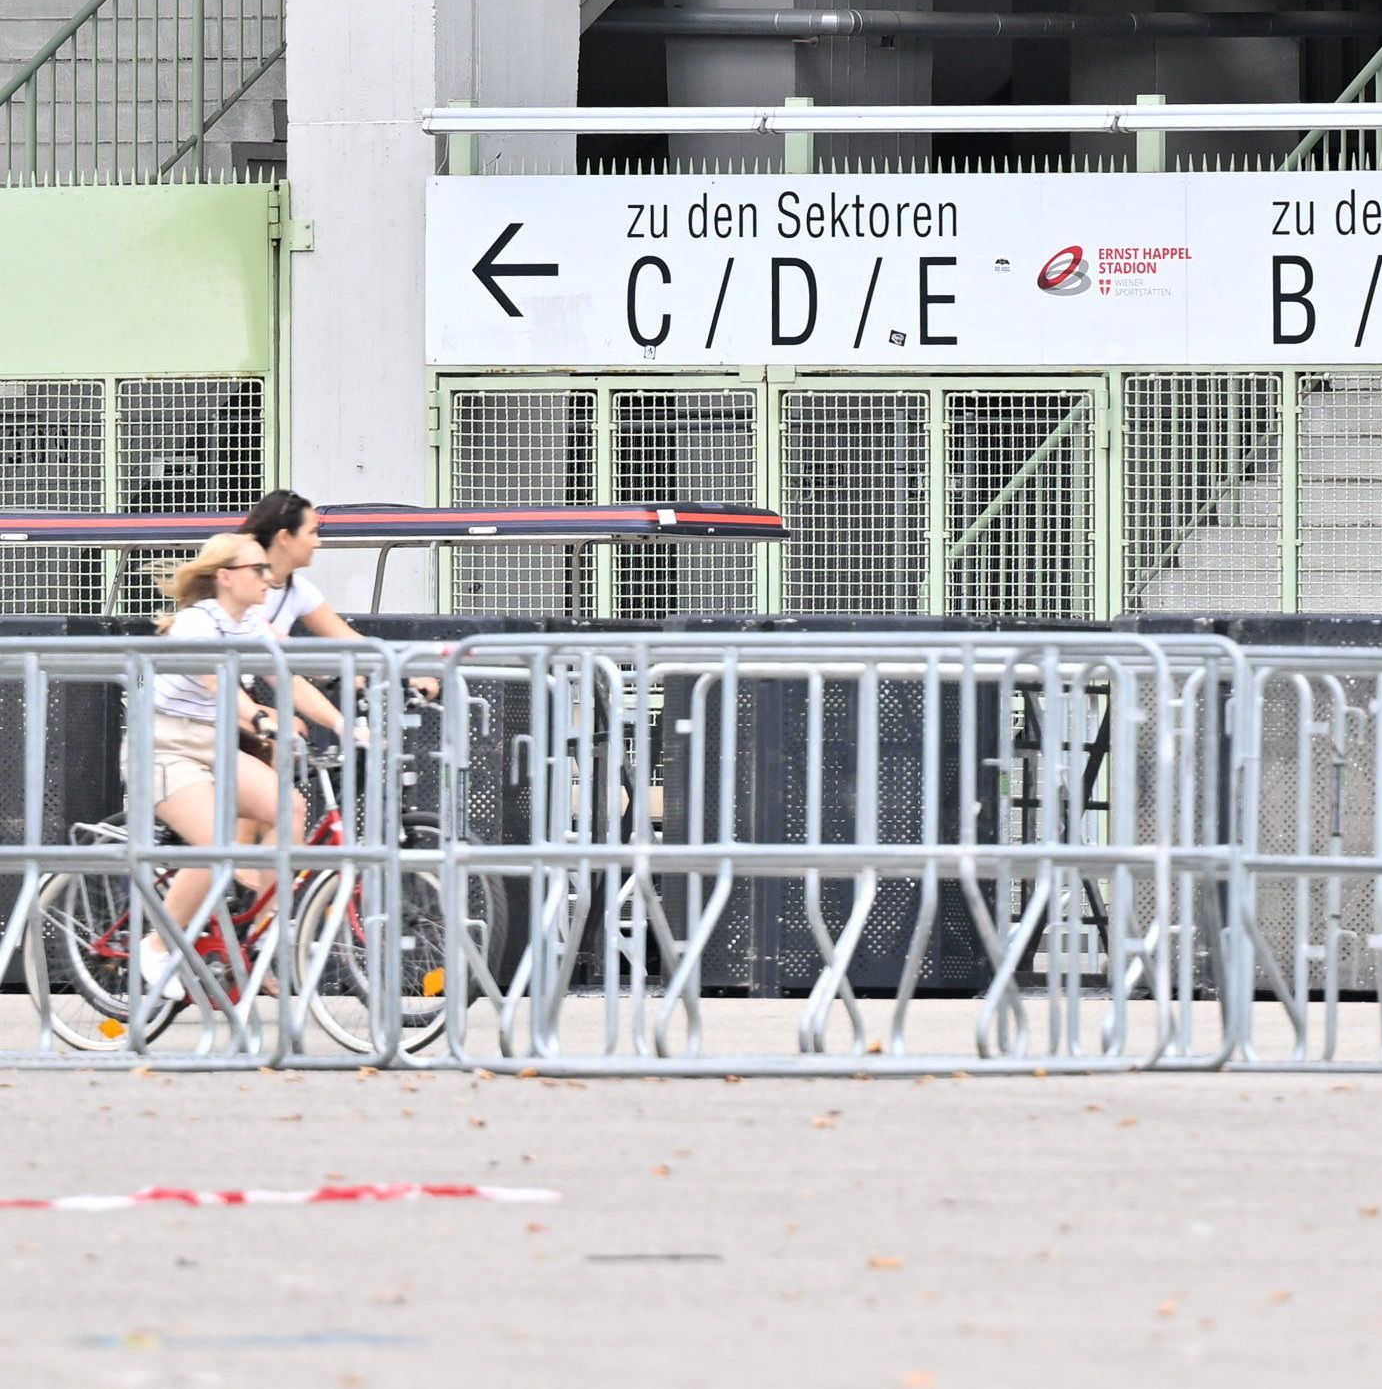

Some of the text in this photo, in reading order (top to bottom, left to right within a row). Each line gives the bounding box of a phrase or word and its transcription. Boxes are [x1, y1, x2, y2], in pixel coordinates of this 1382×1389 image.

[626, 189, 958, 240] zu den Sektoren
[1271, 199, 1316, 237] zu
[1098, 248, 1192, 260] ERNST HAPPEL
[1098, 262, 1157, 274] STADION
[626, 255, 672, 347] C
[771, 257, 818, 346] D
[919, 256, 958, 346] E
[1114, 278, 1144, 287] WIENER
[1272, 254, 1317, 345] B
